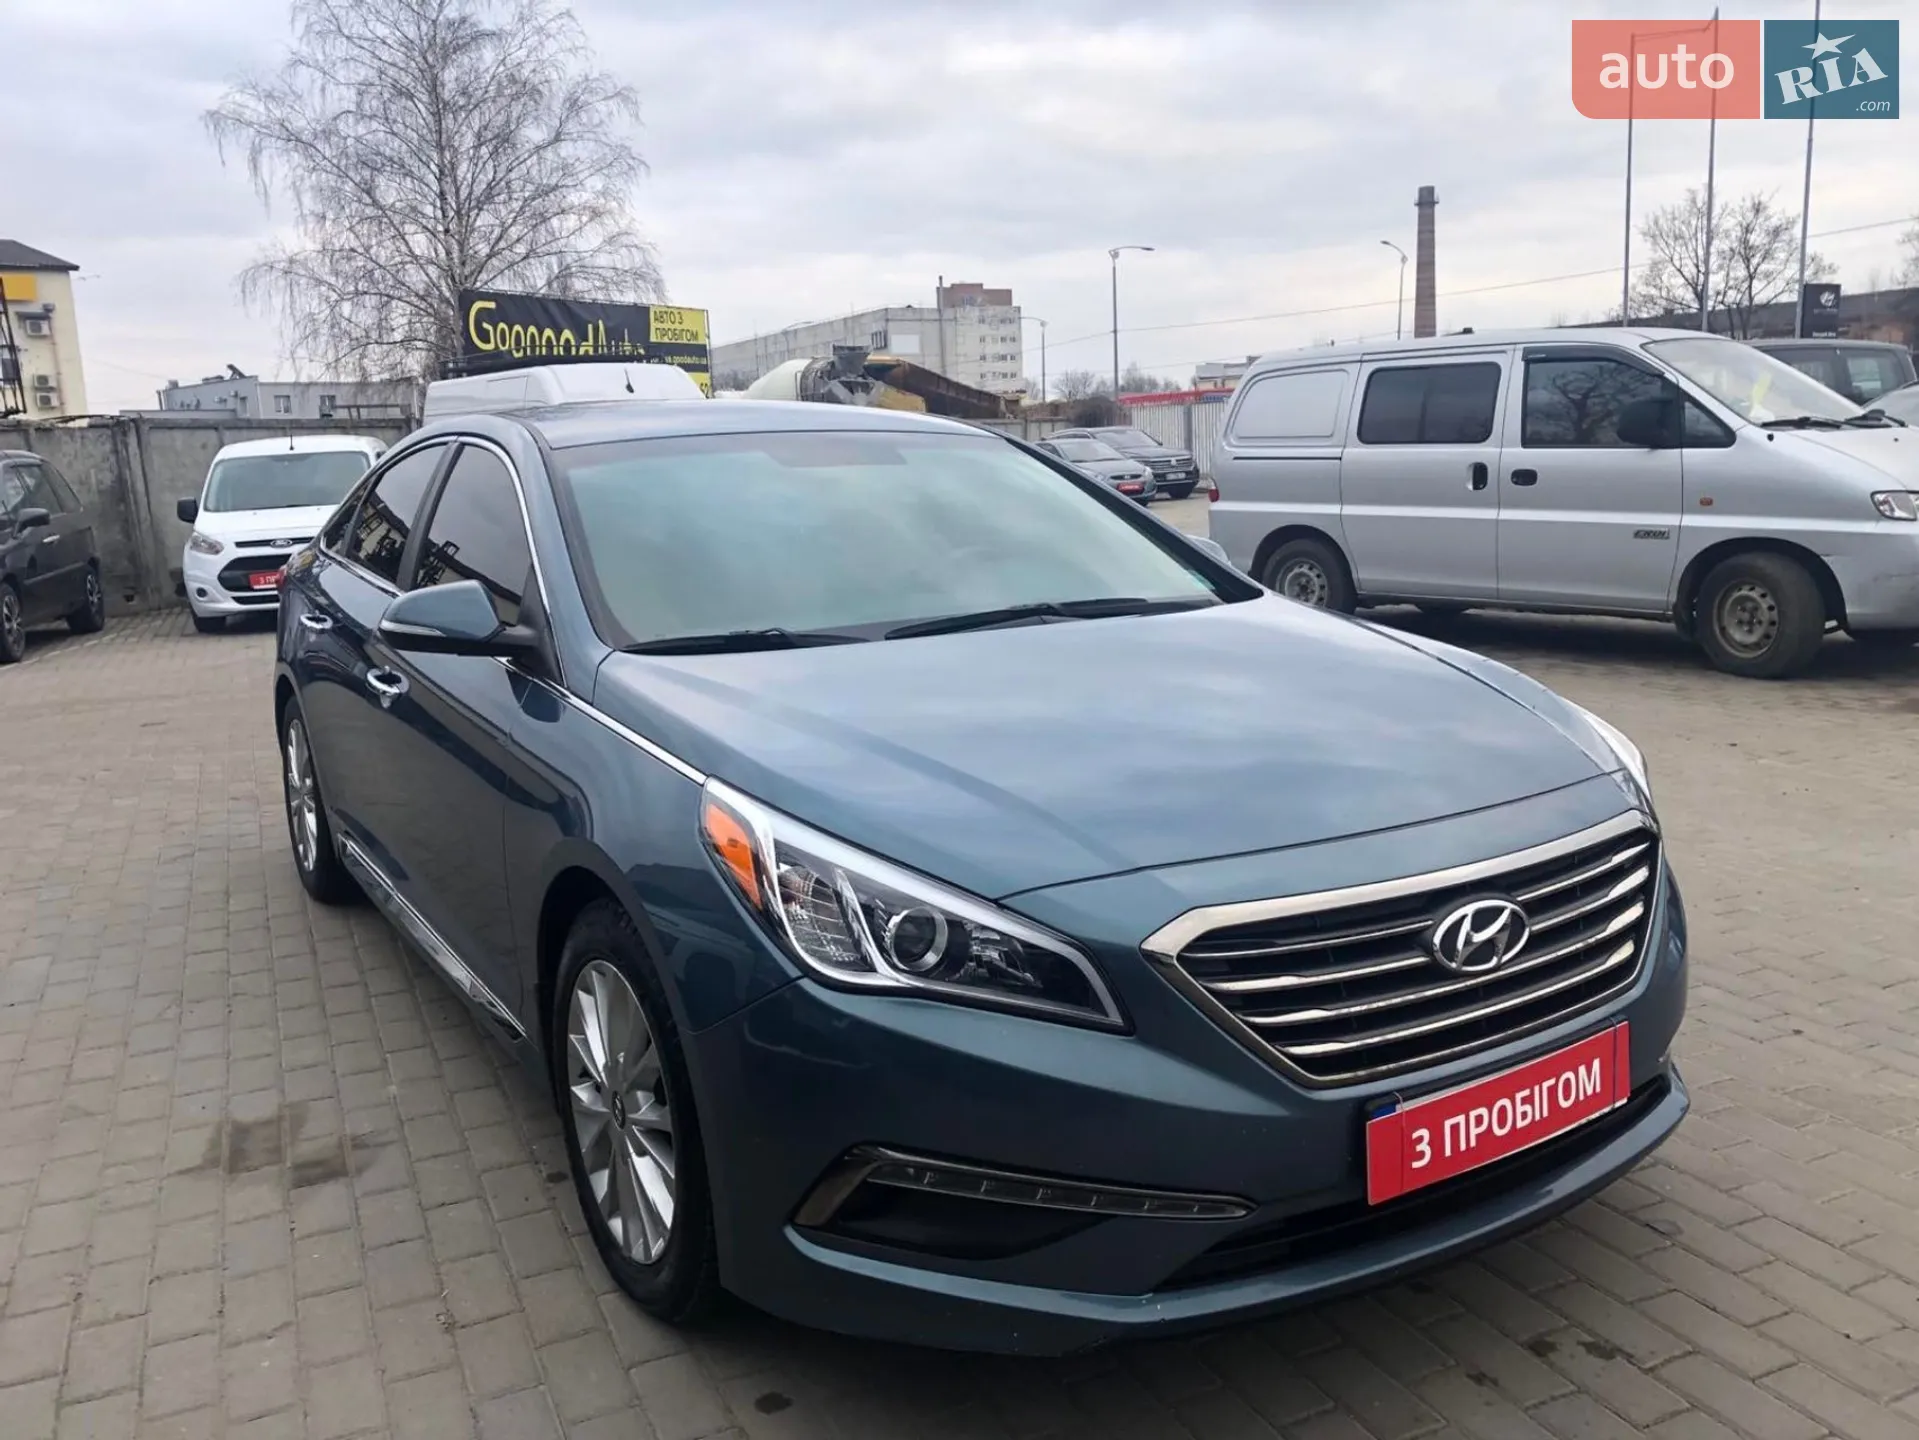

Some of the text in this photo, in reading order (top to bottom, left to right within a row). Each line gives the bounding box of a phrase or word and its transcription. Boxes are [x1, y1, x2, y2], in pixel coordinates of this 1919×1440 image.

[653, 310, 676, 324] АВТО
[654, 327, 699, 342] ПРОБІГОМ
[1443, 1057, 1602, 1158] ПРОБІГОМ
